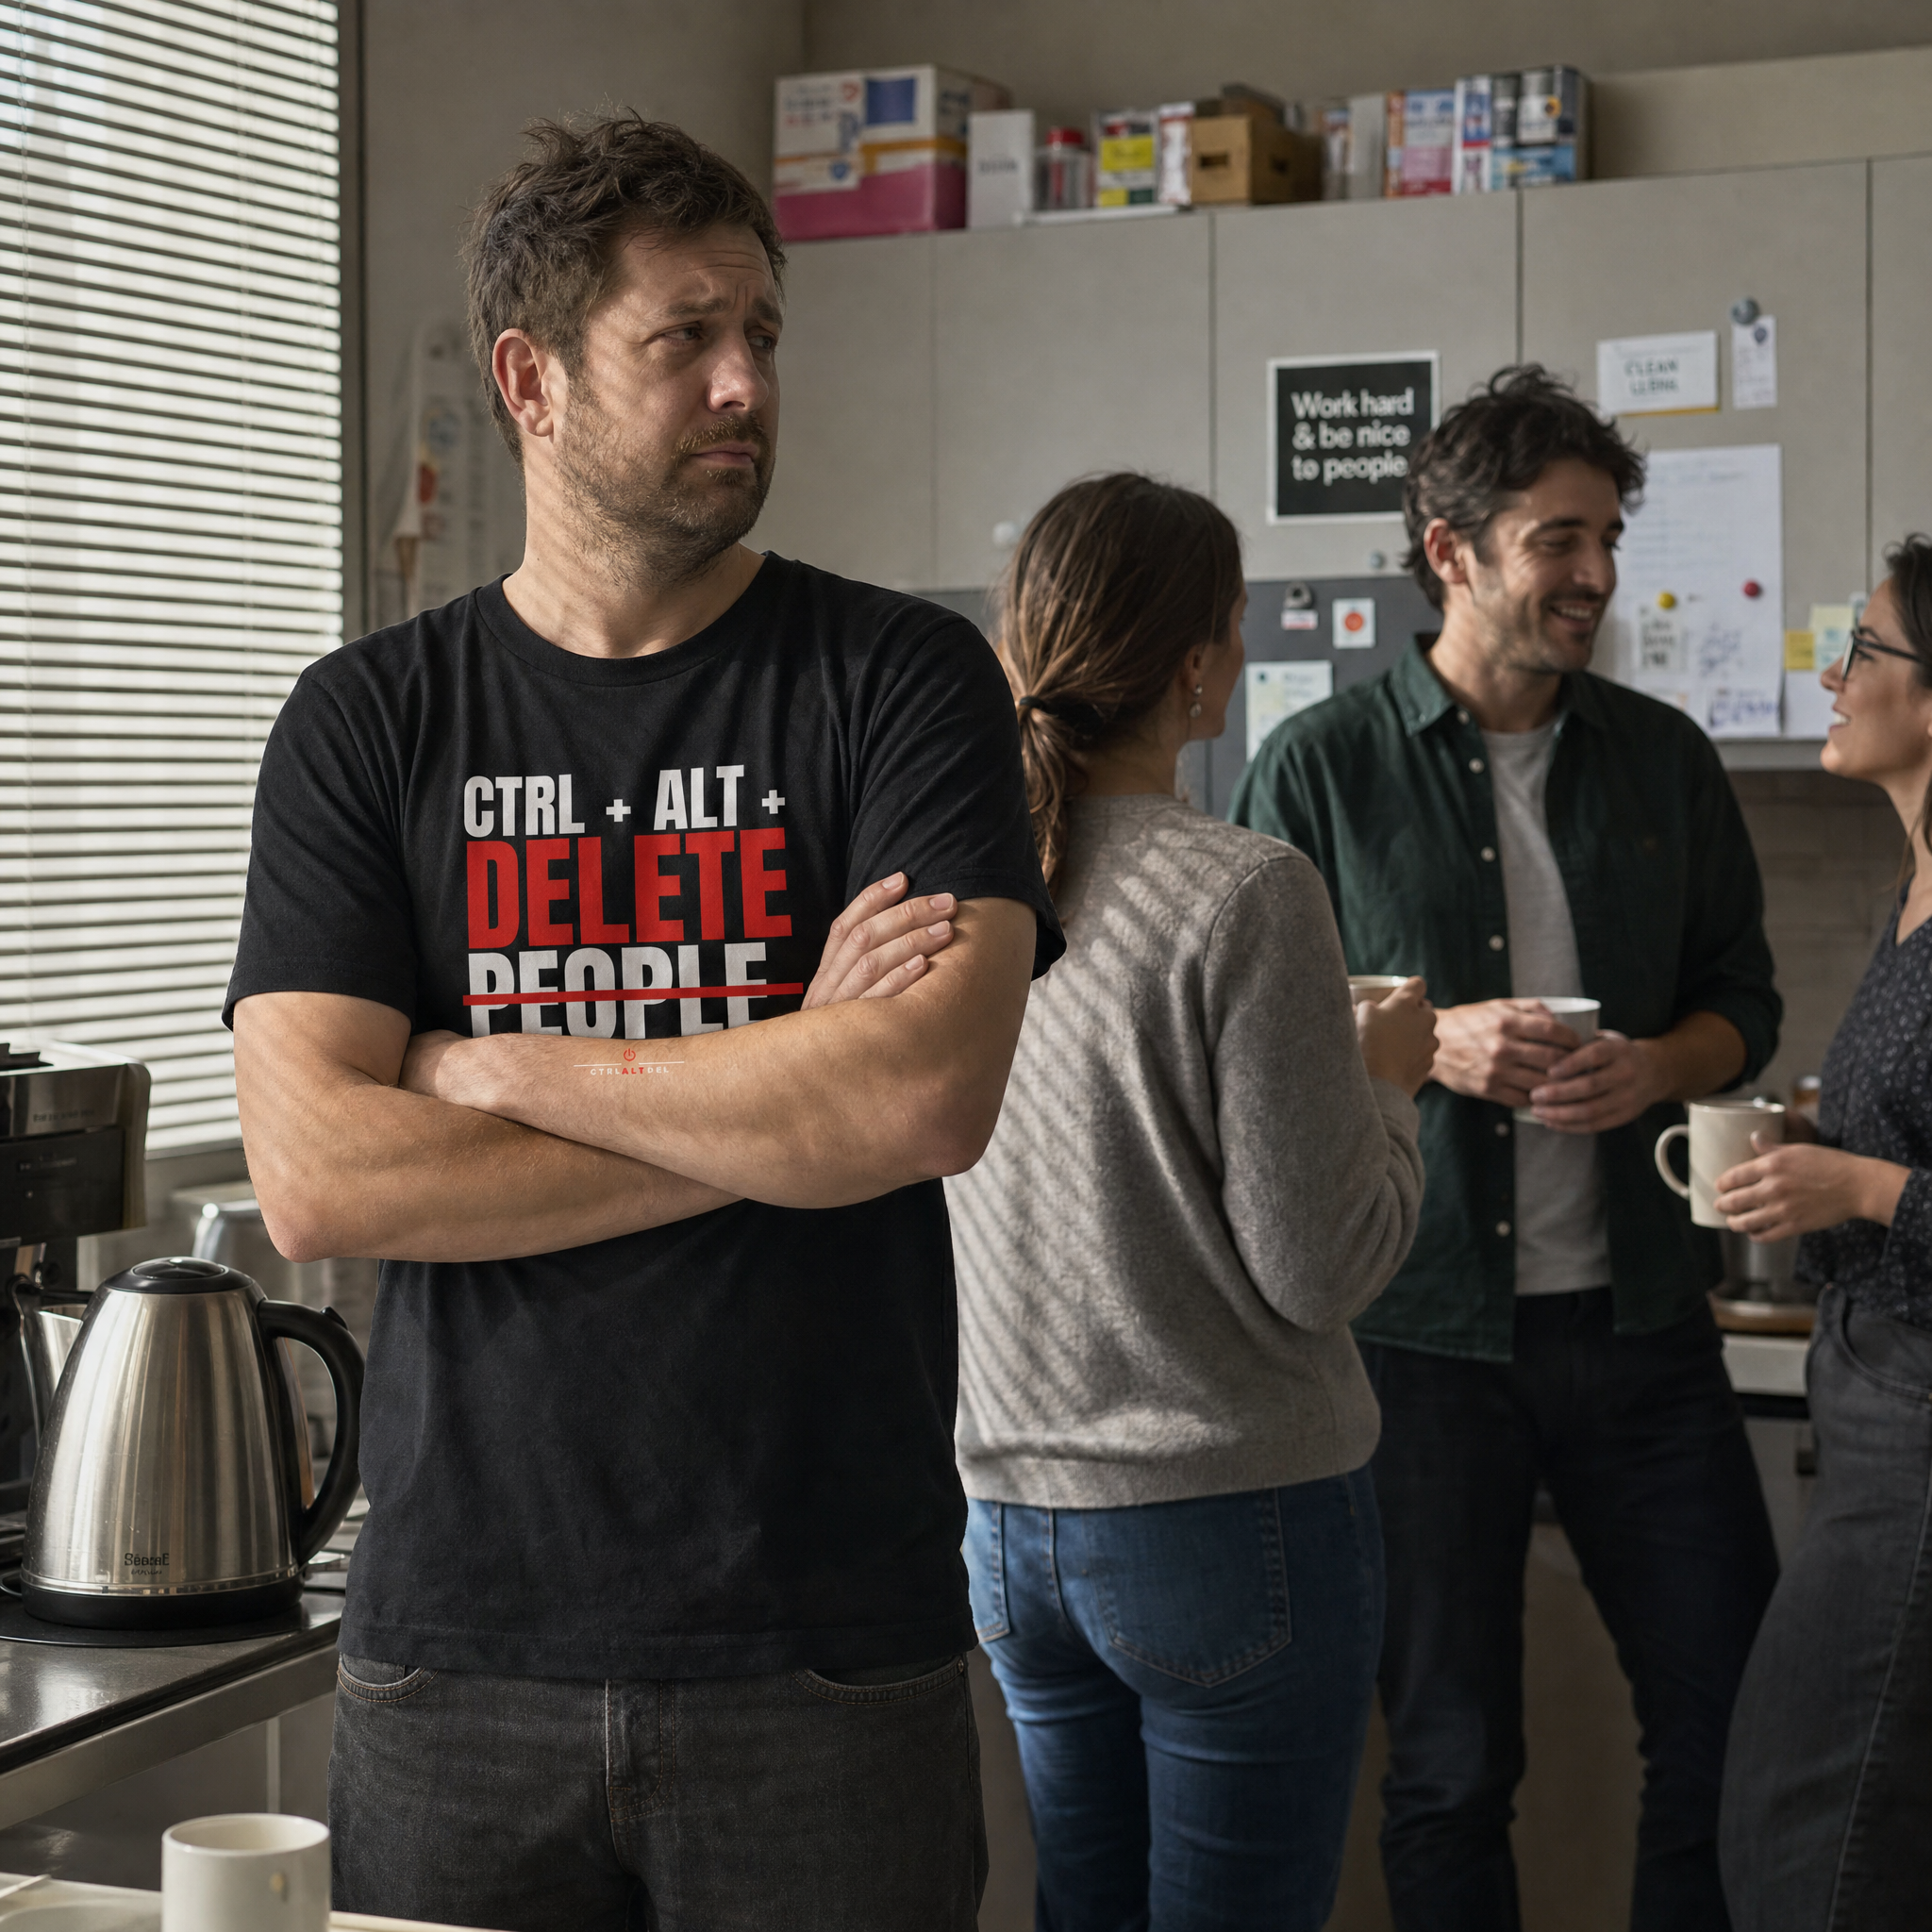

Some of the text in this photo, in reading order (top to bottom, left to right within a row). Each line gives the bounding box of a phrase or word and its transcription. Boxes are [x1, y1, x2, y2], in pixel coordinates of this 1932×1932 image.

[1291, 386, 1415, 420] Work hard
[1291, 418, 1411, 451] & be nice
[1291, 448, 1409, 487] to people
[463, 765, 786, 838] CTRL + ALT +
[466, 827, 792, 949] DELETE
[467, 941, 769, 1040] PEOPLE
